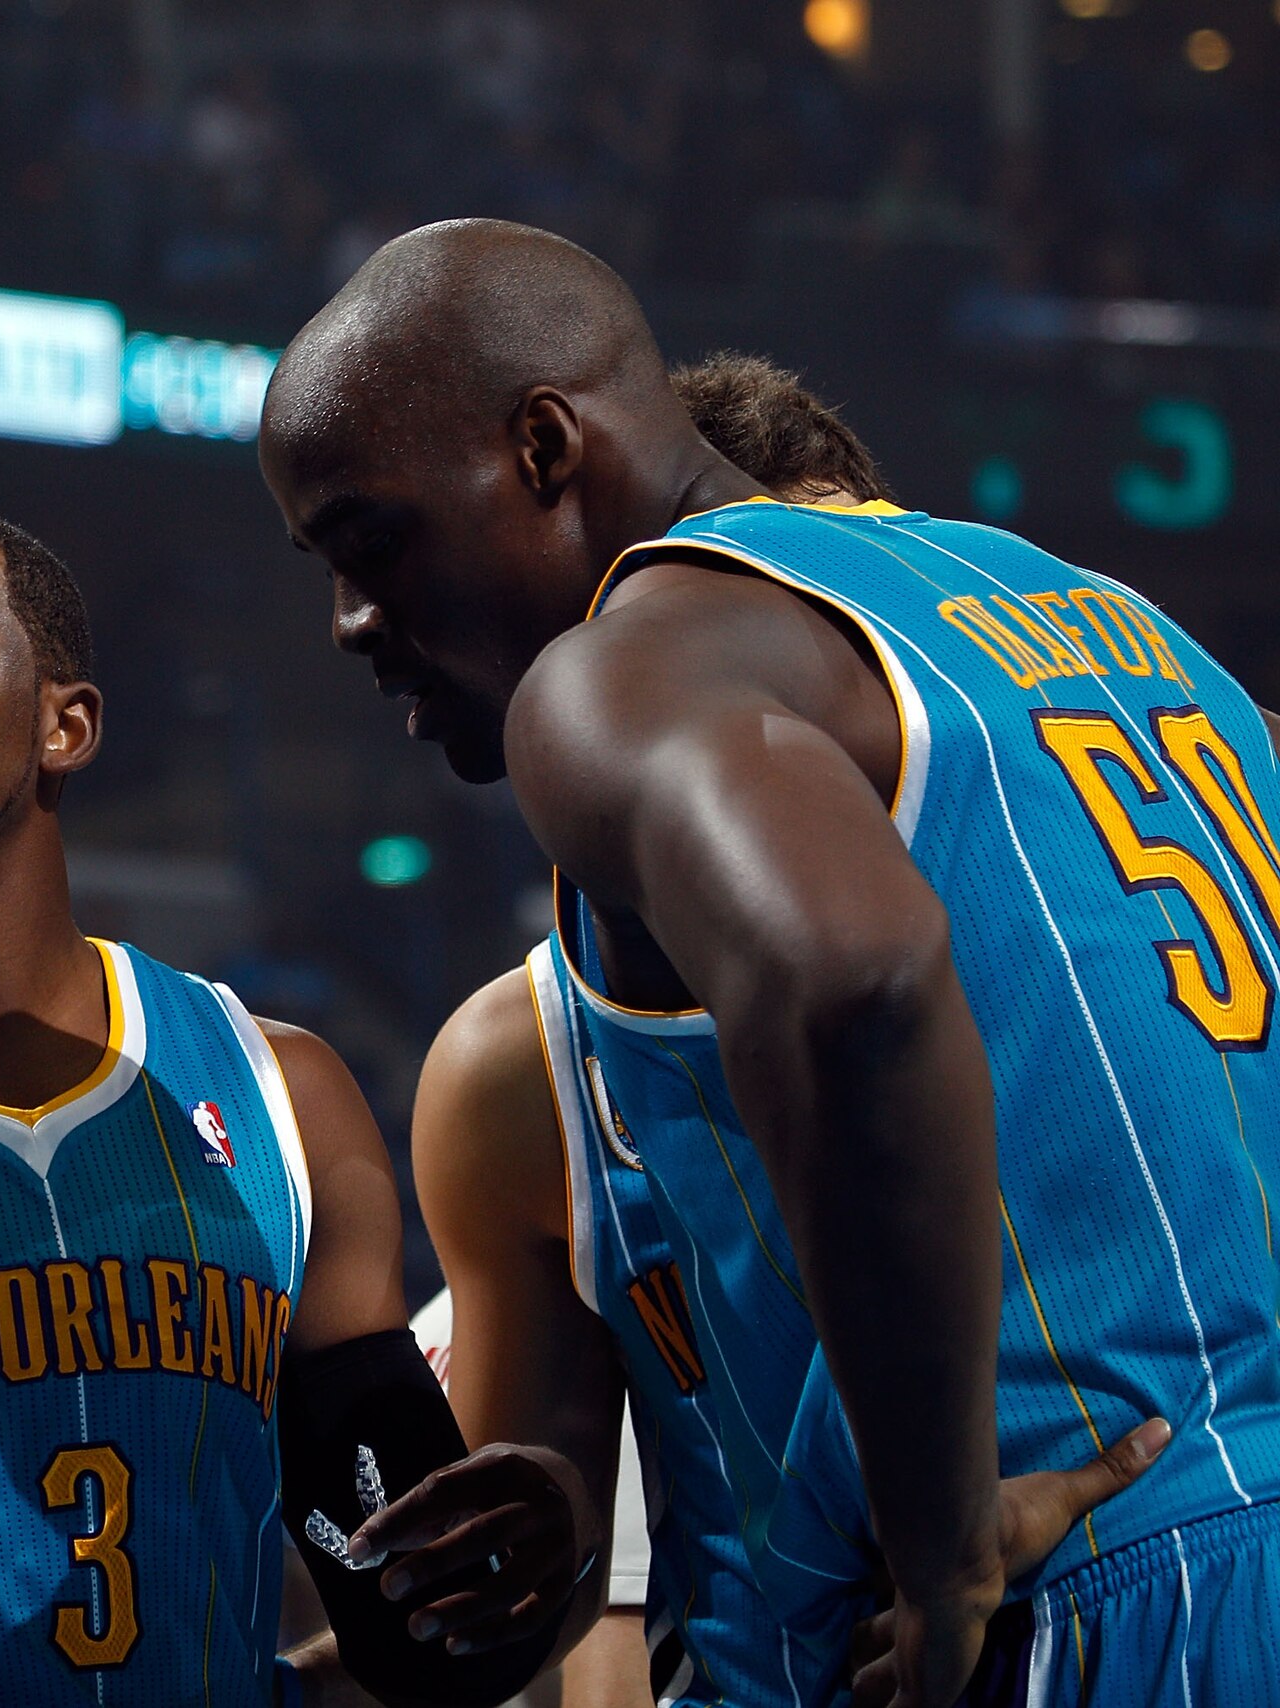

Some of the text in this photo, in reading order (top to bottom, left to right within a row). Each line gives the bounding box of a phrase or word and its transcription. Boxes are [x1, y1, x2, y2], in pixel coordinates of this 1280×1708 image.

[937, 588, 1197, 690] OKAFOR
[204, 1152, 227, 1165] NBA
[36, 1441, 144, 1671] 3
